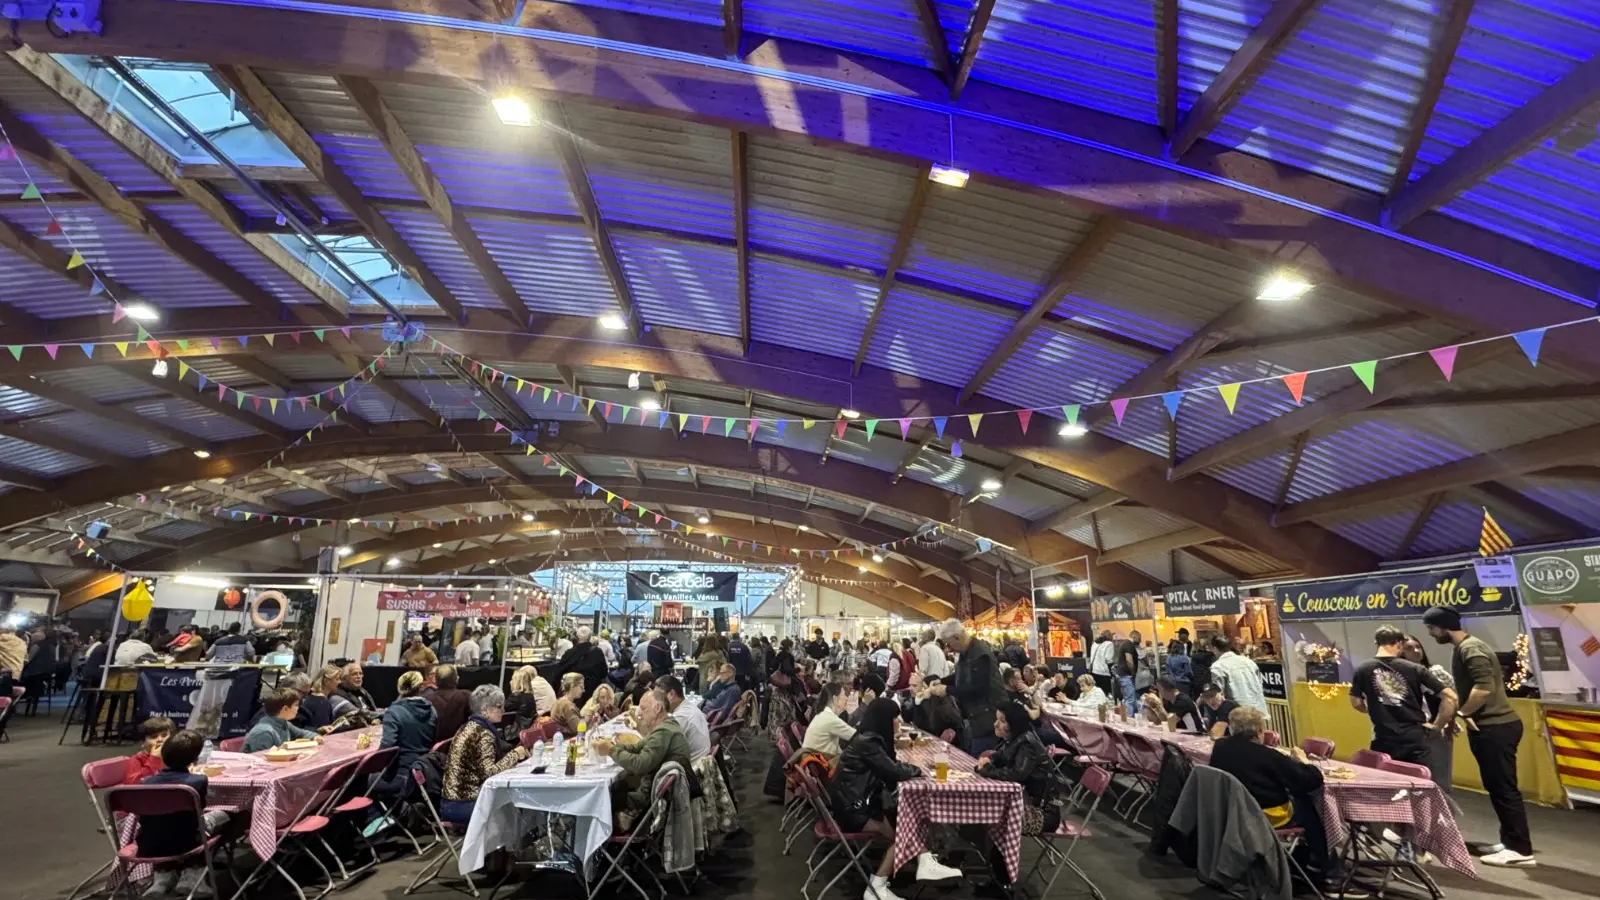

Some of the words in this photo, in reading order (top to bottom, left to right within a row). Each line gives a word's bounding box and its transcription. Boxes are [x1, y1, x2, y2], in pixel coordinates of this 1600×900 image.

[649, 573, 682, 588] Casa
[1526, 568, 1576, 581] GUAPO
[643, 593, 662, 601] Vins,
[664, 593, 695, 601] Vanilles,
[697, 593, 719, 601] Vénus
[1168, 591, 1190, 604] PITA
[1191, 586, 1235, 602] CRNER
[1298, 592, 1362, 613] Couscous
[1366, 593, 1388, 609] en
[1392, 578, 1471, 608] Famille
[386, 600, 426, 610] SUSHIS
[160, 676, 178, 687] Les
